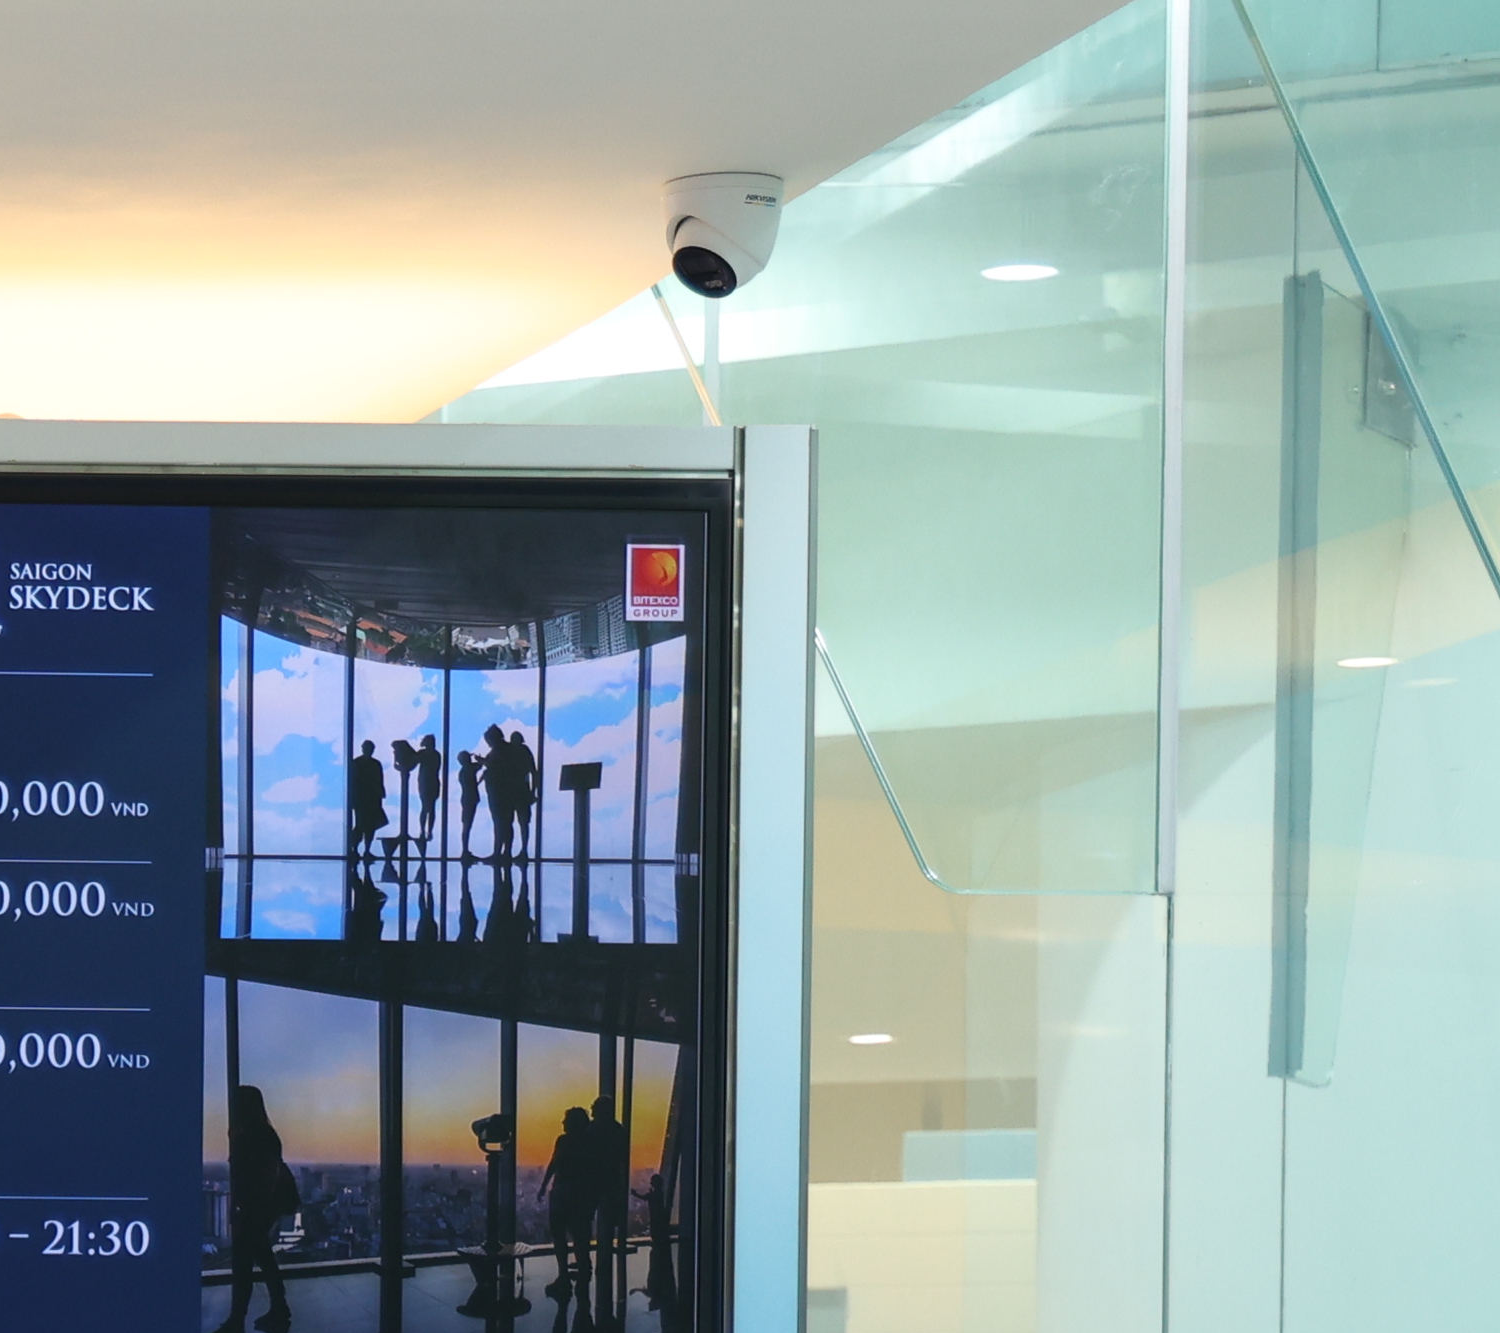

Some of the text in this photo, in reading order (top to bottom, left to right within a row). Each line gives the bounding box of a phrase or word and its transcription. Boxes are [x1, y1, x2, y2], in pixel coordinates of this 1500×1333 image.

[11, 563, 91, 581] SAIGON
[10, 585, 154, 611] SKYDECK
[633, 595, 678, 605] BITEXCO
[633, 608, 678, 618] GROUP
[111, 802, 148, 816] VND
[113, 902, 154, 916] VND
[108, 1054, 149, 1068] VND
[43, 1219, 149, 1257] 21:30
